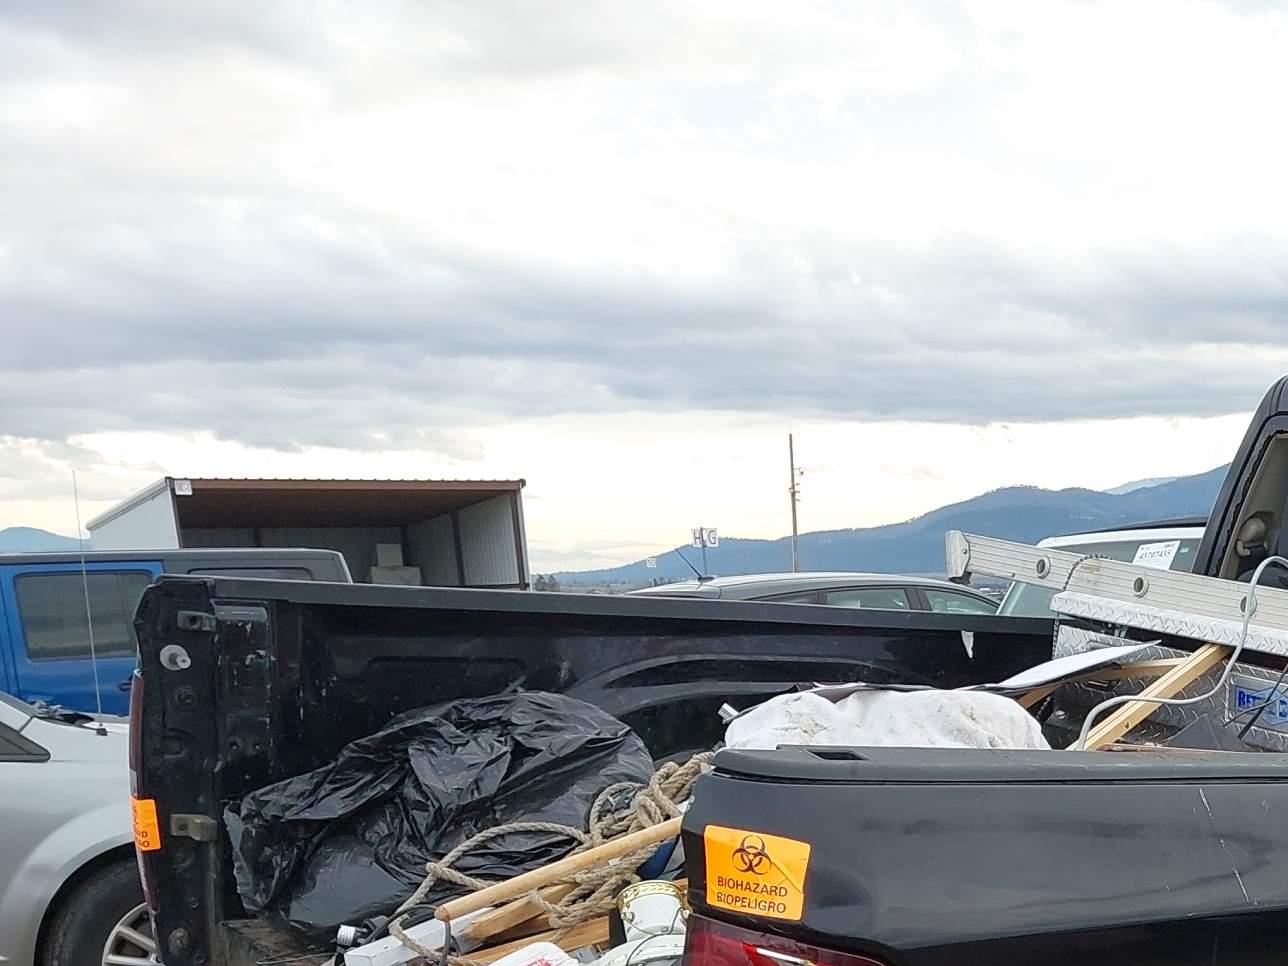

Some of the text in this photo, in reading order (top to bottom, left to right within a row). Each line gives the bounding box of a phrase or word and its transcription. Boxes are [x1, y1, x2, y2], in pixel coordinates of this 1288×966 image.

[707, 529, 717, 545] G
[716, 875, 788, 898] BIOHAZARD
[716, 892, 787, 914] BIOPELIGRO
